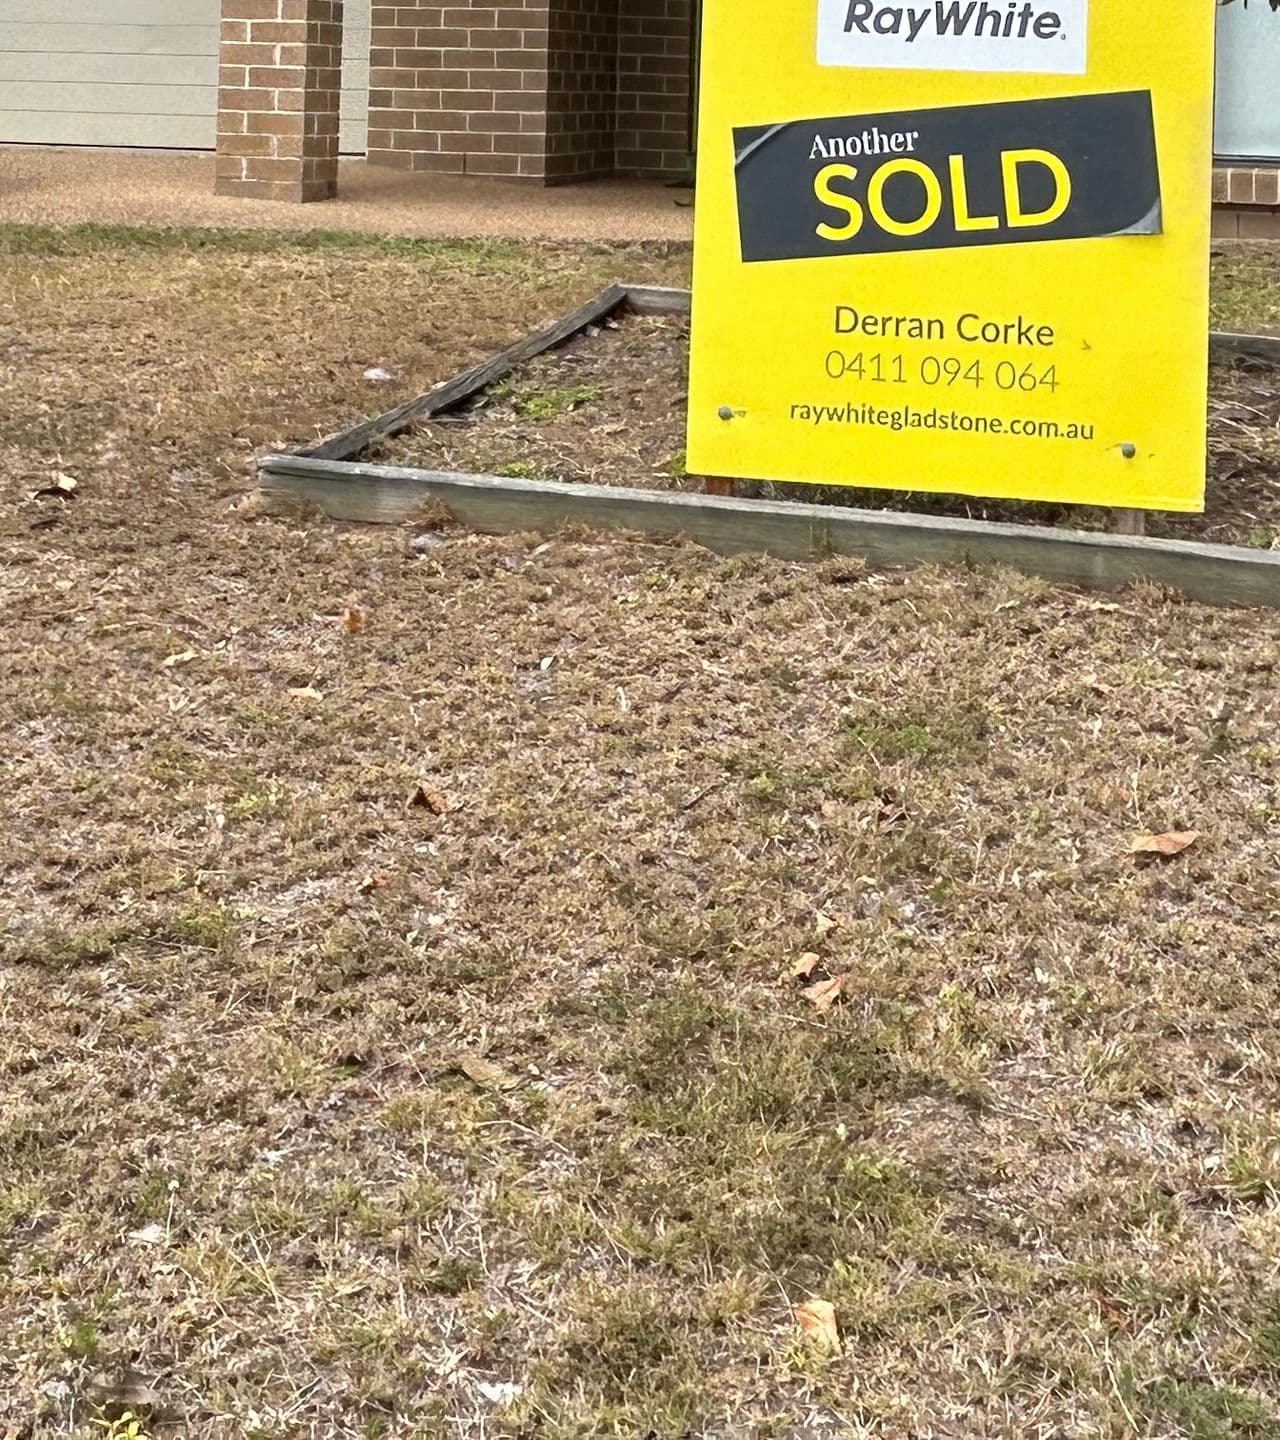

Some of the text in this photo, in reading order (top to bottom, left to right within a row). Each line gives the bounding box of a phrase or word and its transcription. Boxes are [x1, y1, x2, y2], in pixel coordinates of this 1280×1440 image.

[808, 126, 919, 160] Another
[815, 149, 1070, 241] SOLD
[834, 306, 1055, 347] Derran Corke
[825, 350, 1060, 394] 0411 094 064
[790, 402, 1094, 440] raywhitegladstone.com.au
